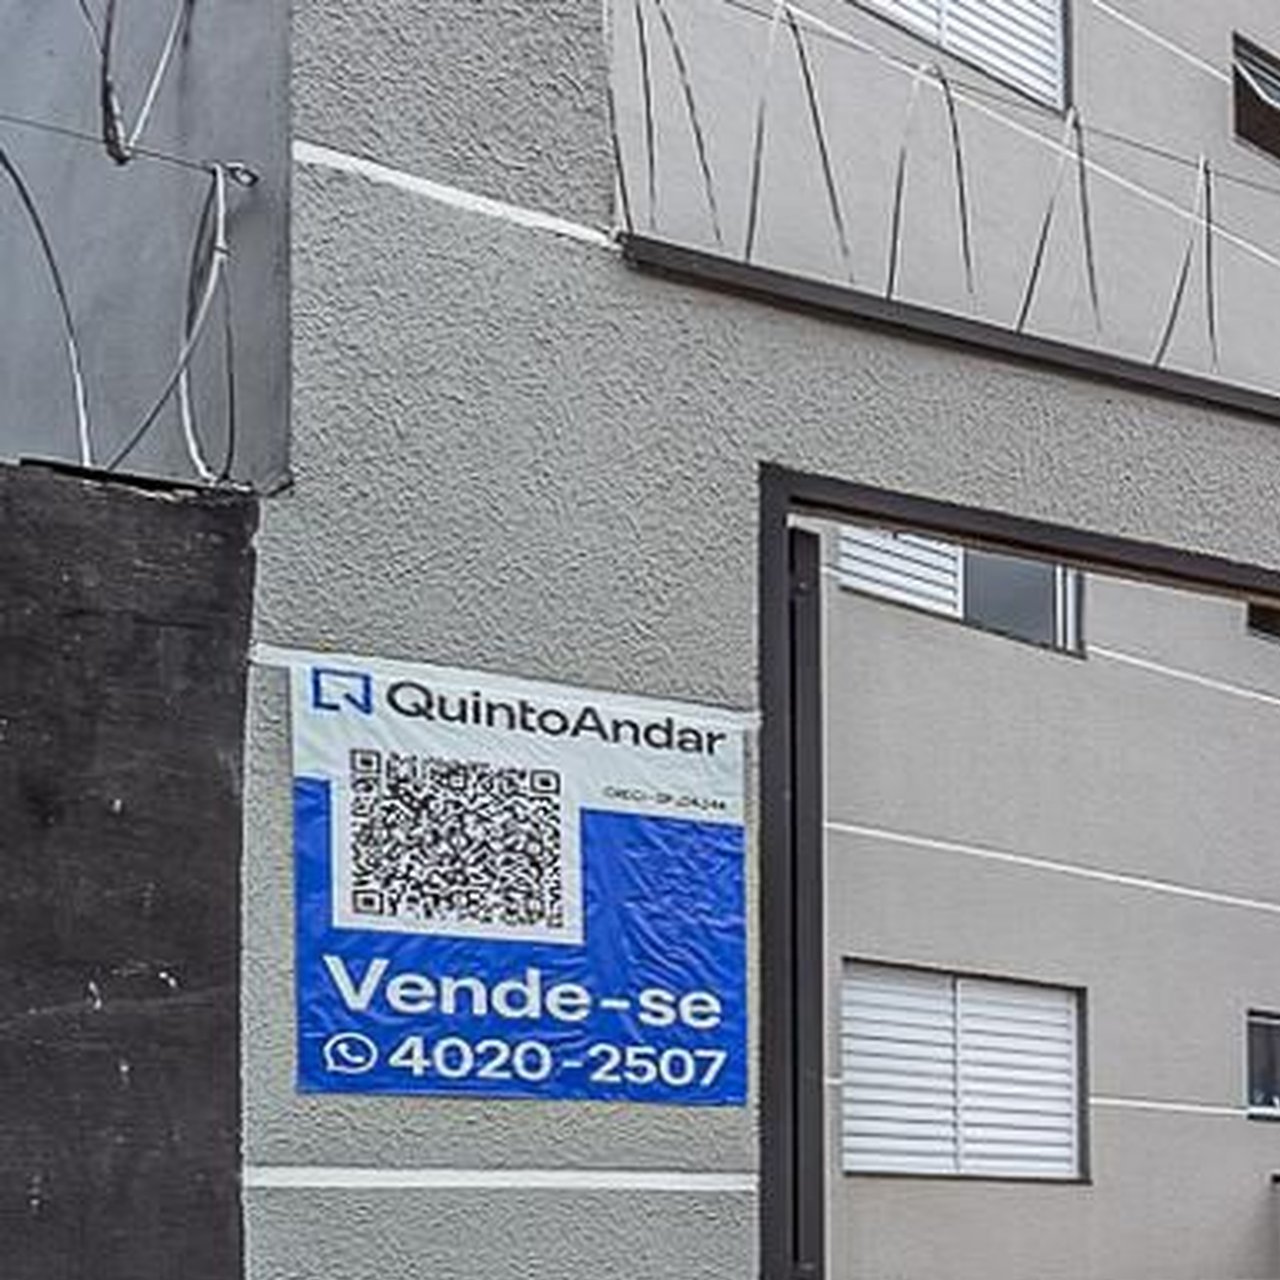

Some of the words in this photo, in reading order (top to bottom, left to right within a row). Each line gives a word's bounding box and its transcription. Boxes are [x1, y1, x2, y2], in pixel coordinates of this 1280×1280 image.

[386, 681, 726, 756] QuintoAndar
[322, 954, 722, 1030] Vende-se
[387, 1035, 727, 1087] 4020-2507
